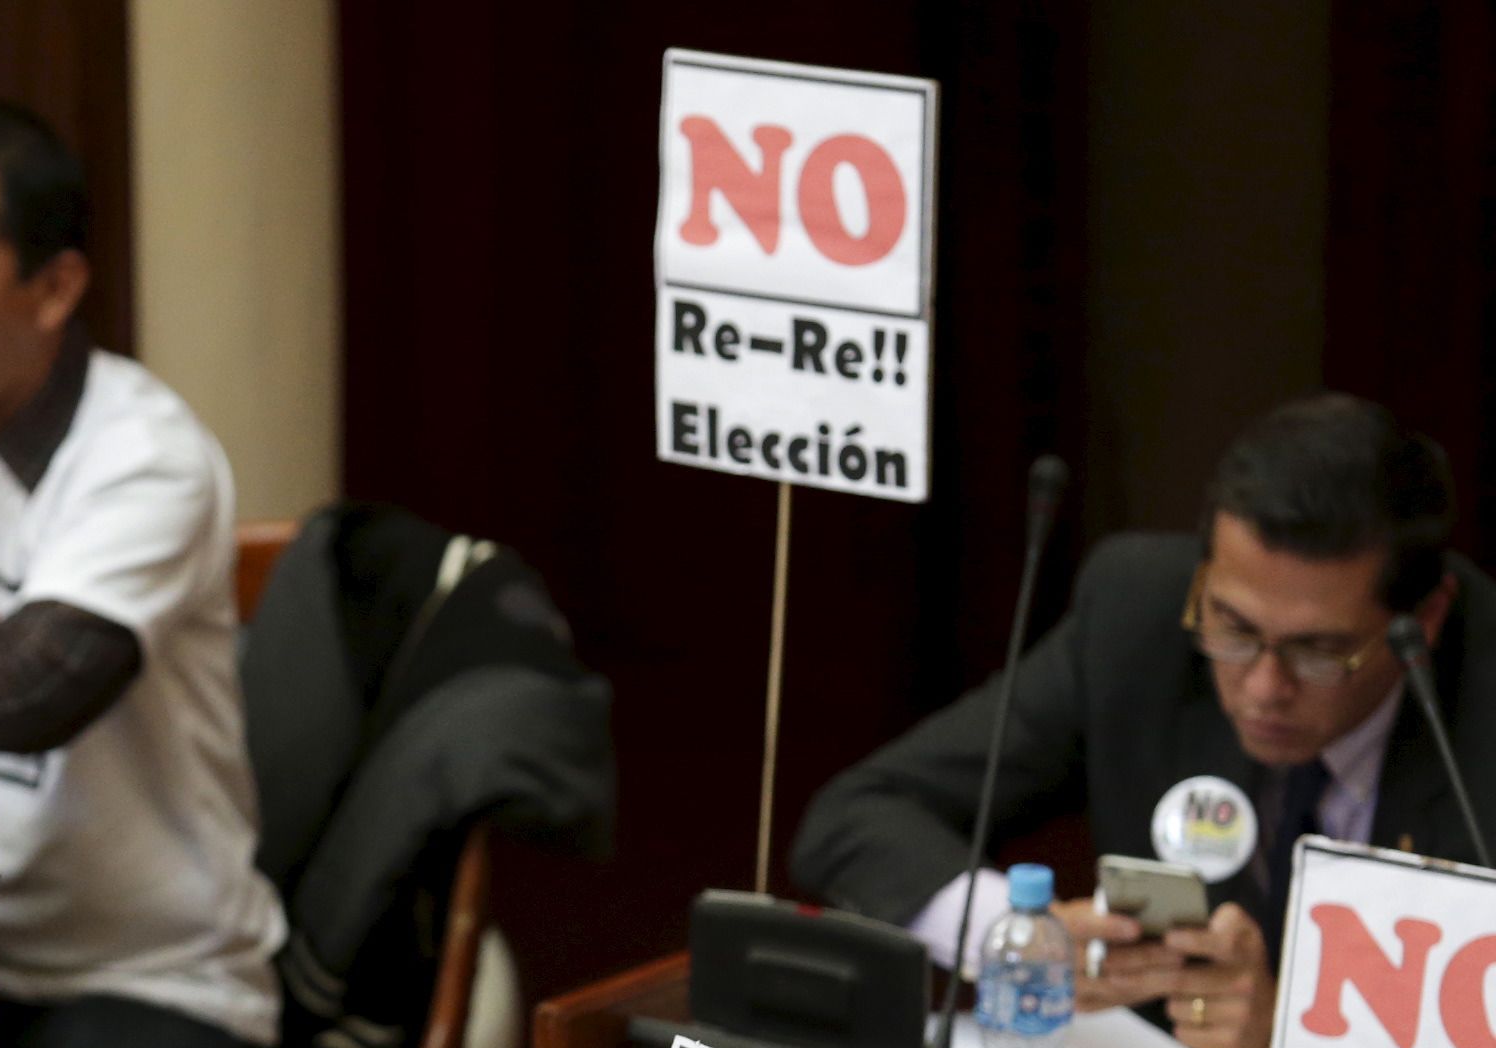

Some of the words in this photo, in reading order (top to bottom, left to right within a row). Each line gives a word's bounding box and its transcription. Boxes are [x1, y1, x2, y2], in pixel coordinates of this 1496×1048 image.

[679, 114, 908, 267] NO
[672, 300, 908, 387] Re-Re!!
[671, 399, 908, 489] Elección
